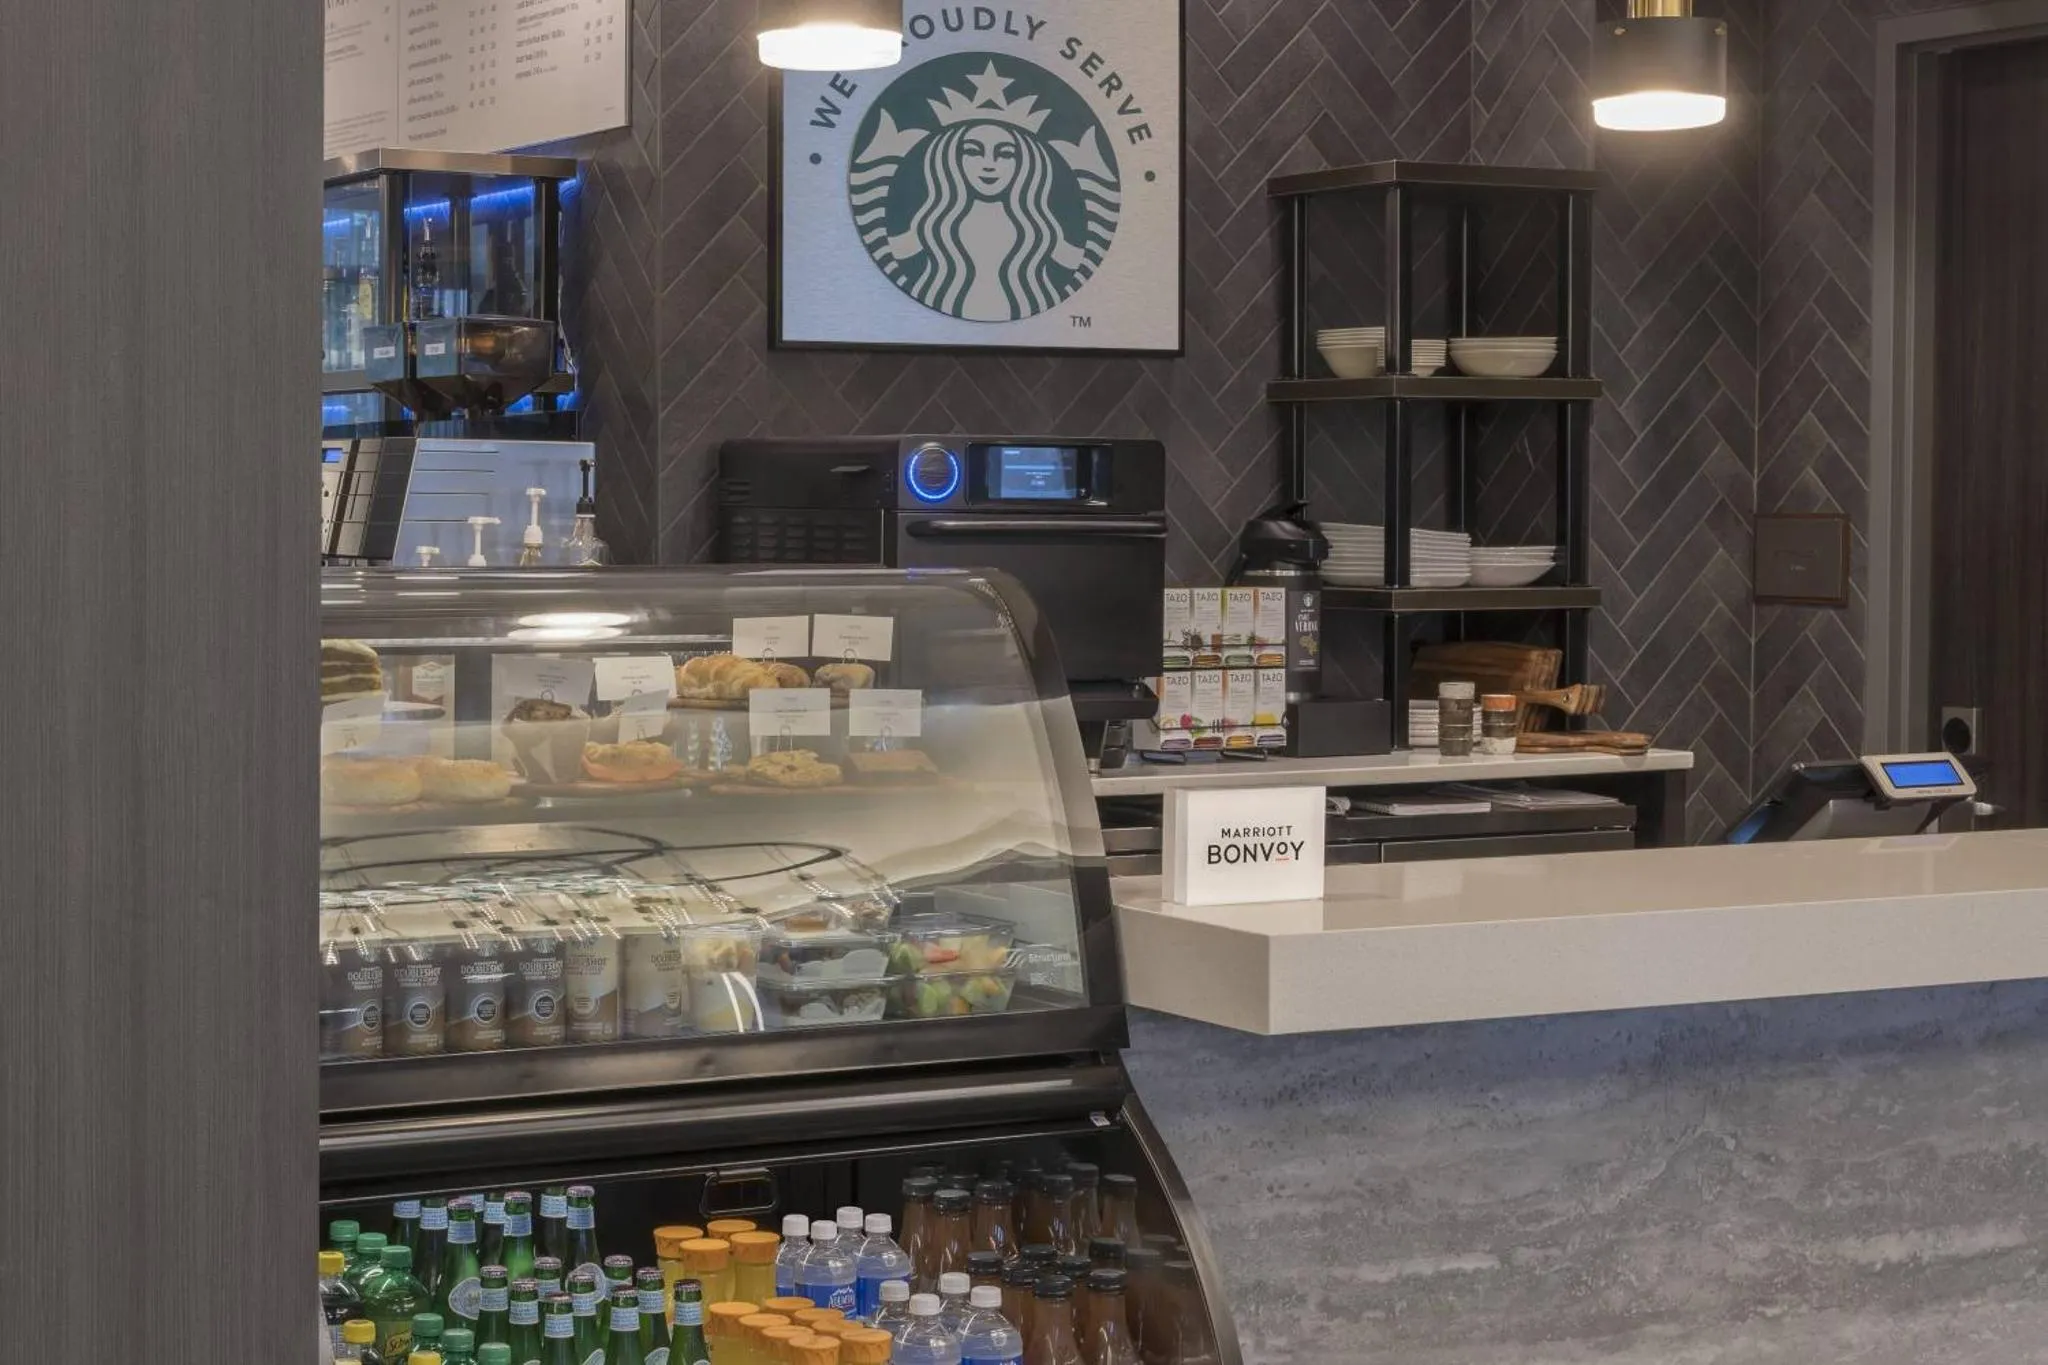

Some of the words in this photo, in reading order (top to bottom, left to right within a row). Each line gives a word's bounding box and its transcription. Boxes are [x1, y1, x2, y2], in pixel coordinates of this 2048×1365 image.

[809, 72, 859, 131] WE
[902, 6, 1048, 47] OUDLY
[1058, 36, 1153, 145] SERVE
[1070, 315, 1092, 328] TM
[1166, 593, 1189, 602] TAZO
[1196, 592, 1219, 602] TAZO
[1229, 592, 1251, 602] TAZO
[1260, 592, 1283, 601] TAZO
[1166, 676, 1189, 686] TAZO
[1197, 674, 1220, 684] TAZO
[1230, 673, 1251, 683] TAZO
[1261, 673, 1283, 683] TAZO
[1221, 825, 1293, 838] MARRIOTT
[1207, 840, 1305, 865] BONVOY
